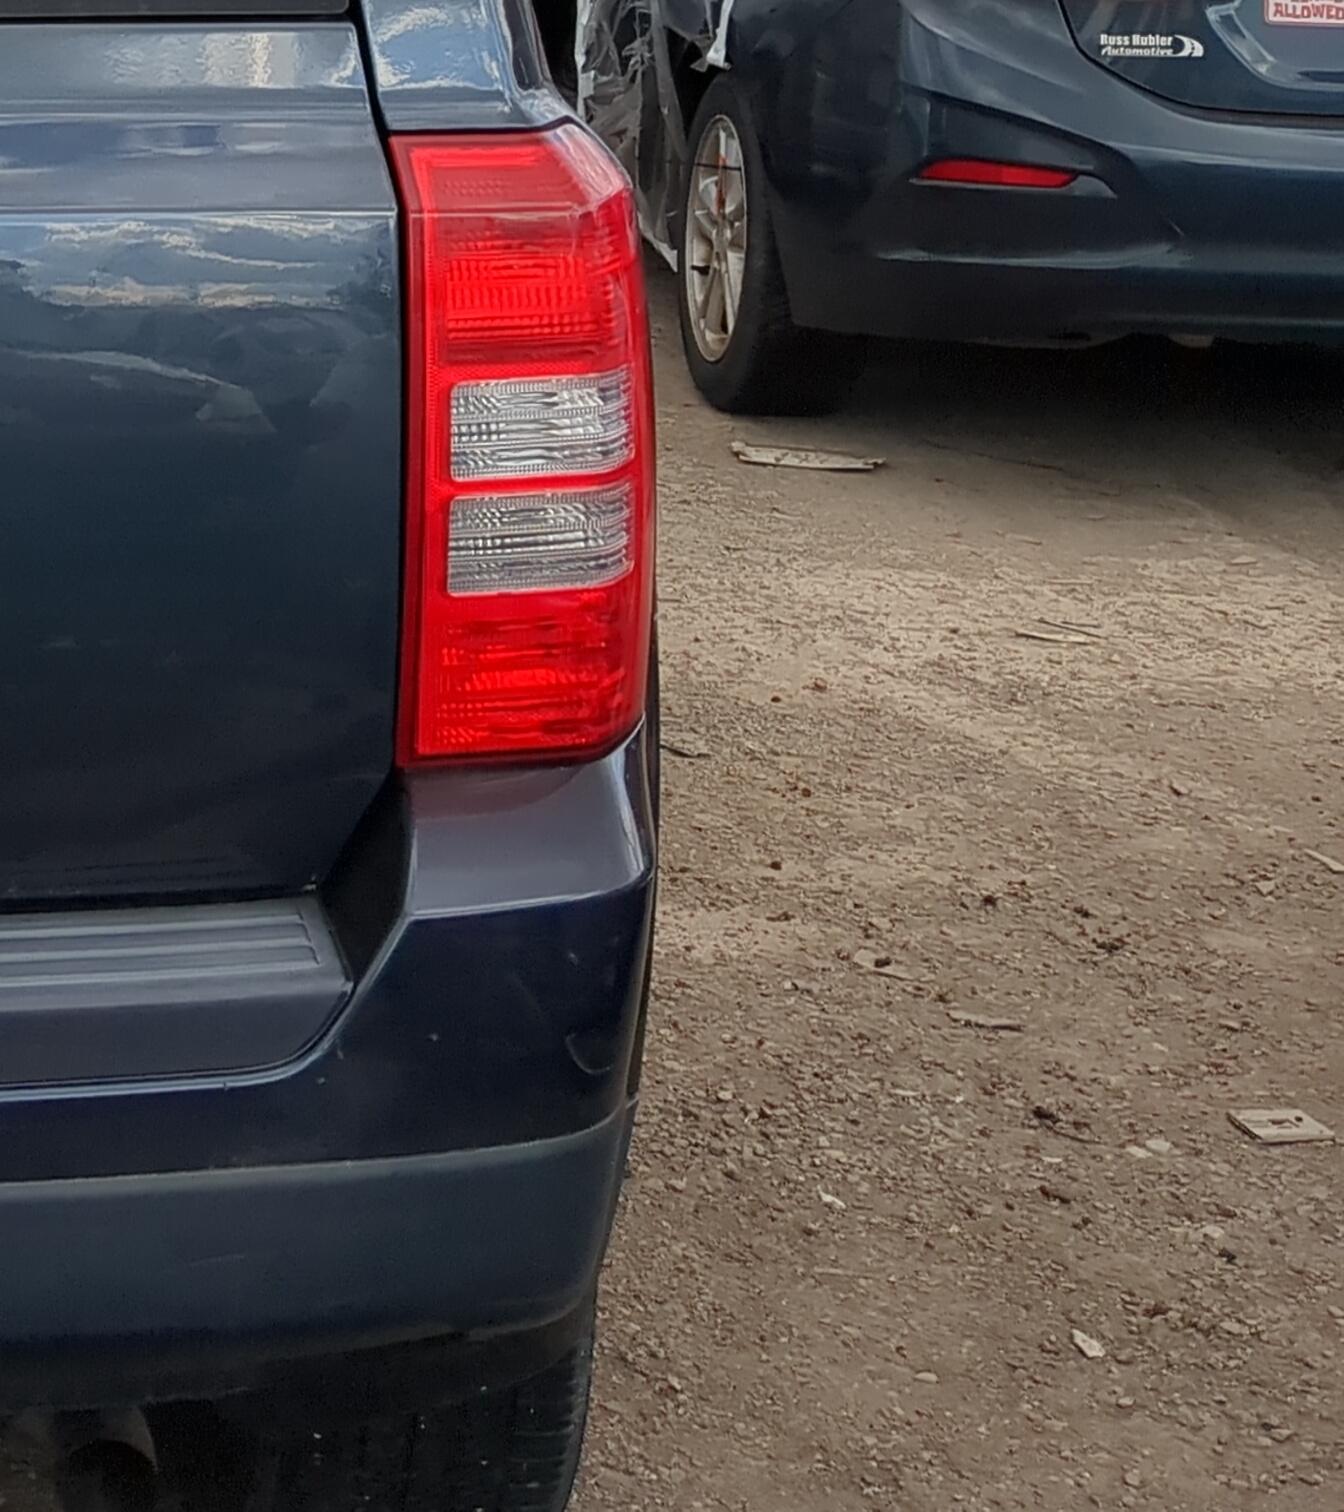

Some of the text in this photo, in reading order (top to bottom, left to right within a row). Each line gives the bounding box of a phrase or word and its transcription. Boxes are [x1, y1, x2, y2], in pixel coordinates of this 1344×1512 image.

[1273, 3, 1344, 20] ALLOWED
[1100, 34, 1173, 47] Russ Hubler
[1101, 46, 1174, 56] Automotive
